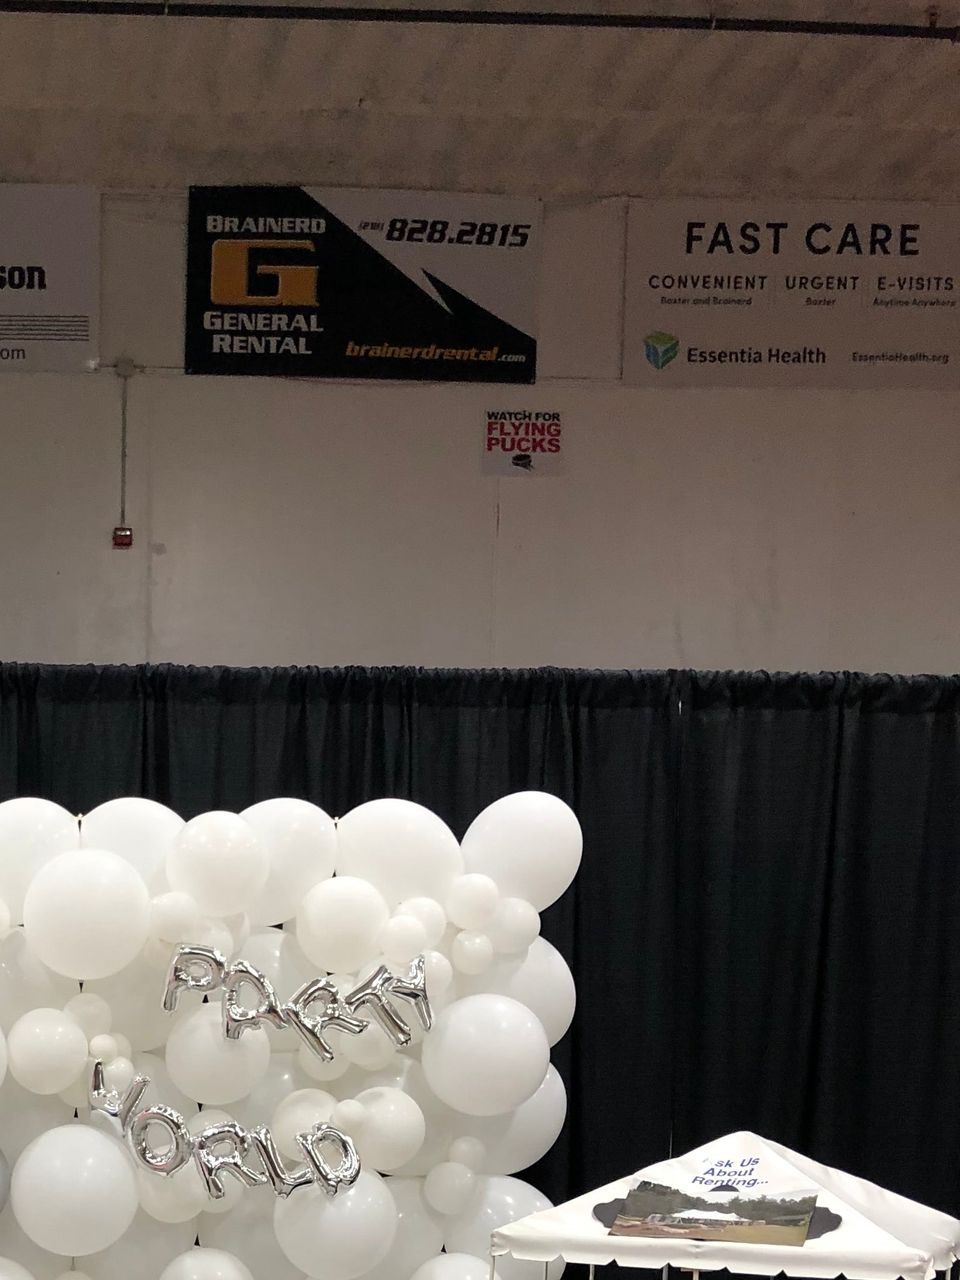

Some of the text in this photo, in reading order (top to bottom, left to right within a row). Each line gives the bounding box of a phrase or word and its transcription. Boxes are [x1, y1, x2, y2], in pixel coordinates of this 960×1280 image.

[206, 215, 326, 234] BRAINERD
[385, 218, 531, 247] 828.2815
[686, 222, 920, 256] FAST CARE
[211, 239, 320, 307] G
[648, 275, 955, 292] CONVENIENT URGENT E-VISITS
[203, 311, 324, 332] GENERAL
[212, 334, 313, 355] RENTAL
[345, 341, 526, 363] brainerdrental.com
[687, 346, 827, 364] Essentia Health
[487, 410, 561, 422] WATCH FOR
[487, 421, 561, 437] FLYING
[487, 437, 561, 453] PUCKS
[161, 942, 433, 1063] PARTY
[88, 1057, 362, 1200] WORLD
[703, 1167, 755, 1178] About
[740, 1157, 761, 1168] Us
